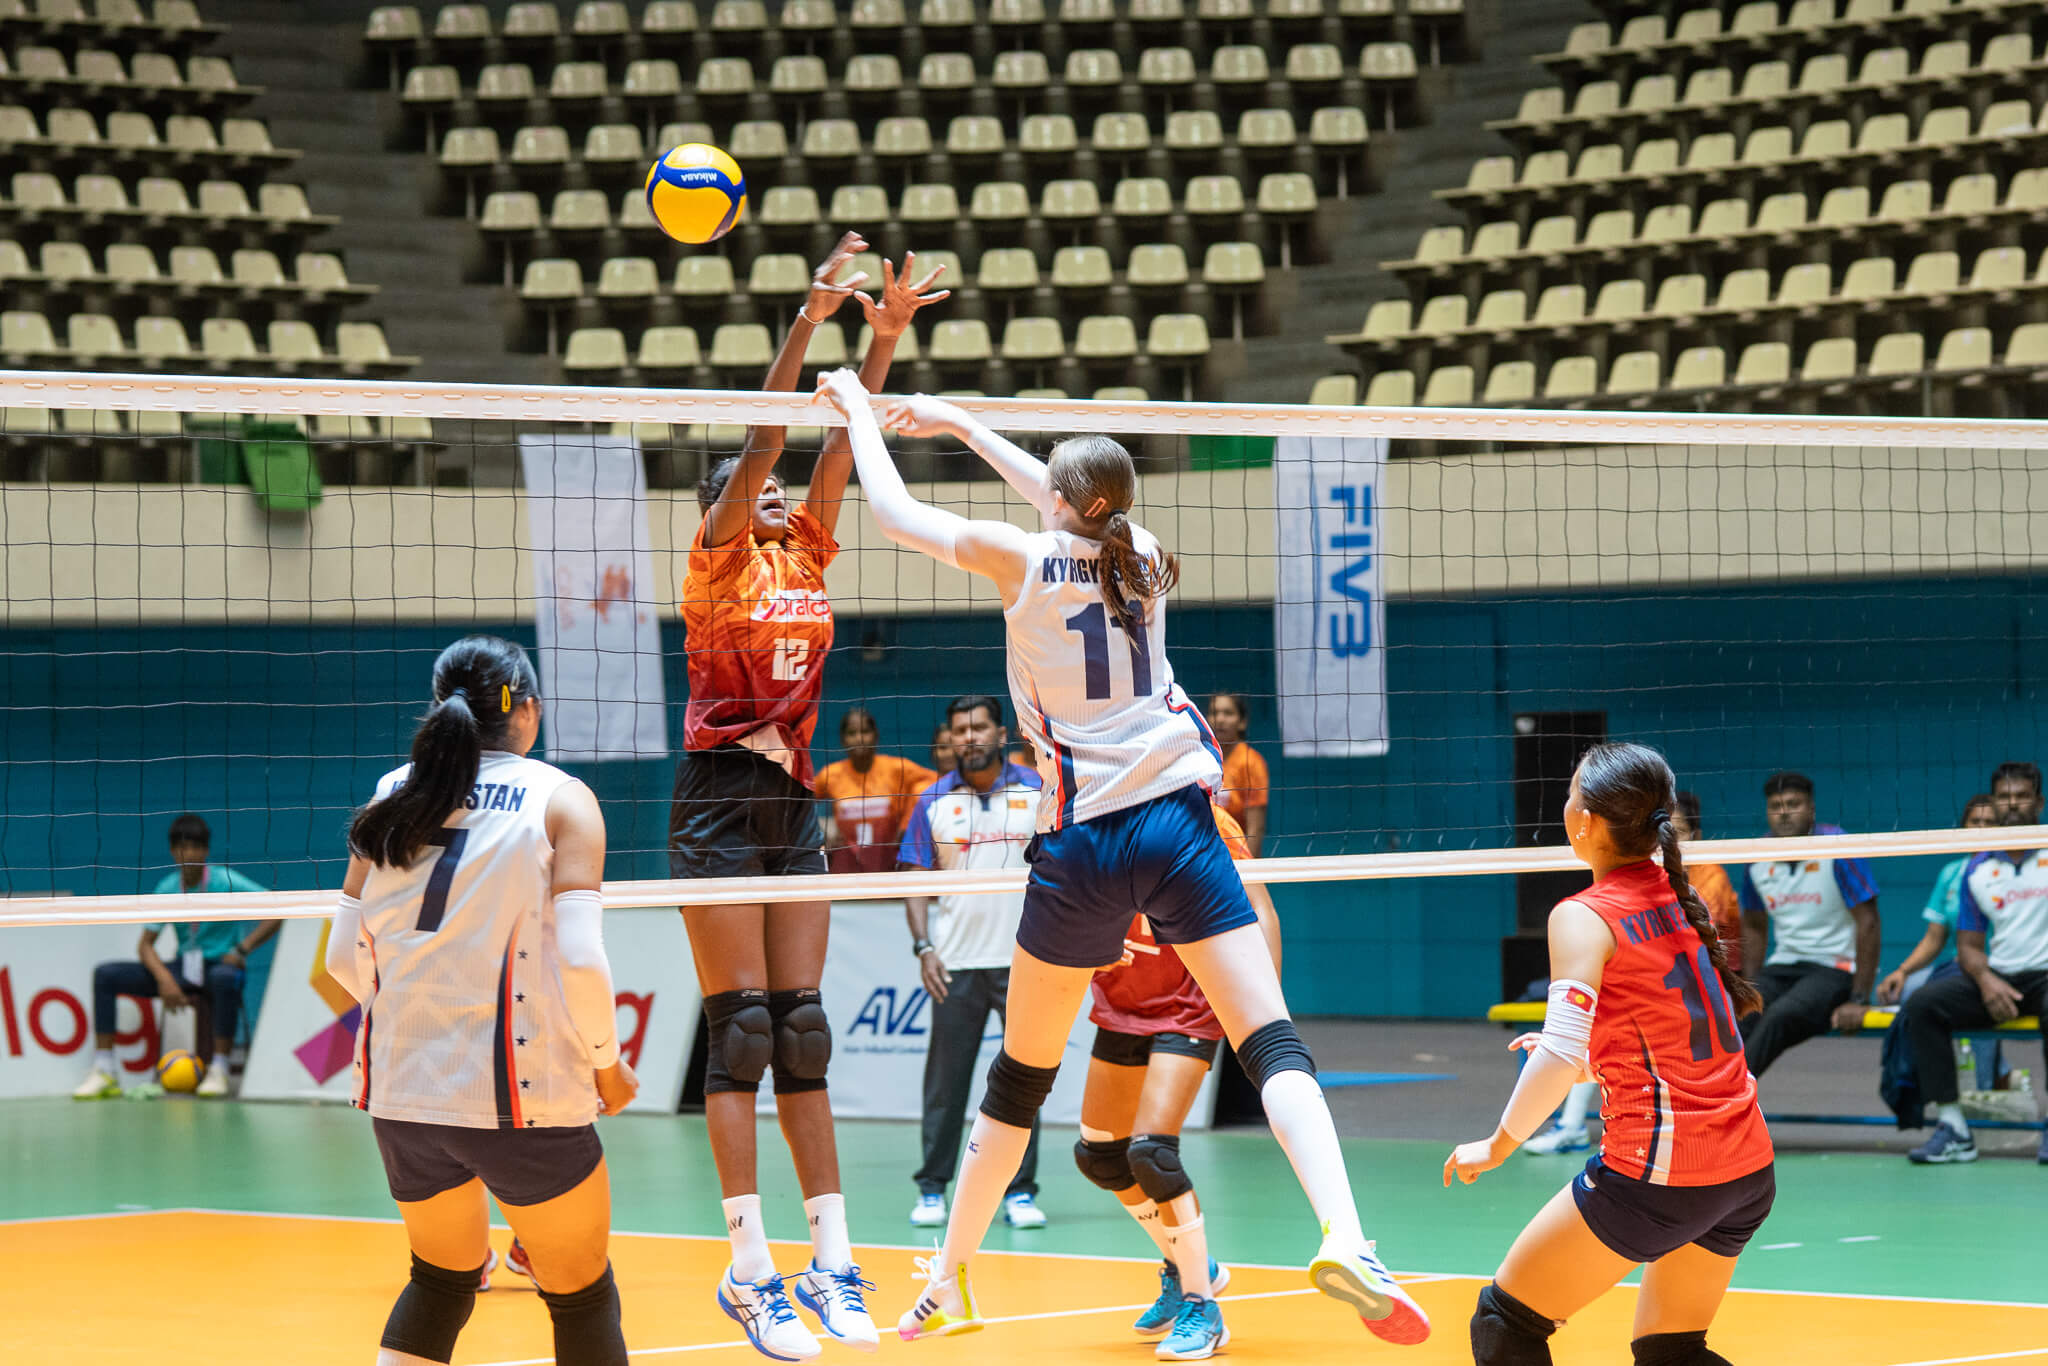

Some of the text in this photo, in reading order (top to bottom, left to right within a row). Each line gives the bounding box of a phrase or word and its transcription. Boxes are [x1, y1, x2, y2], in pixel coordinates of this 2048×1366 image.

[772, 637, 810, 681] 12
[1066, 600, 1152, 700] 11
[416, 828, 470, 932] 7
[1662, 943, 1744, 1062] 10
